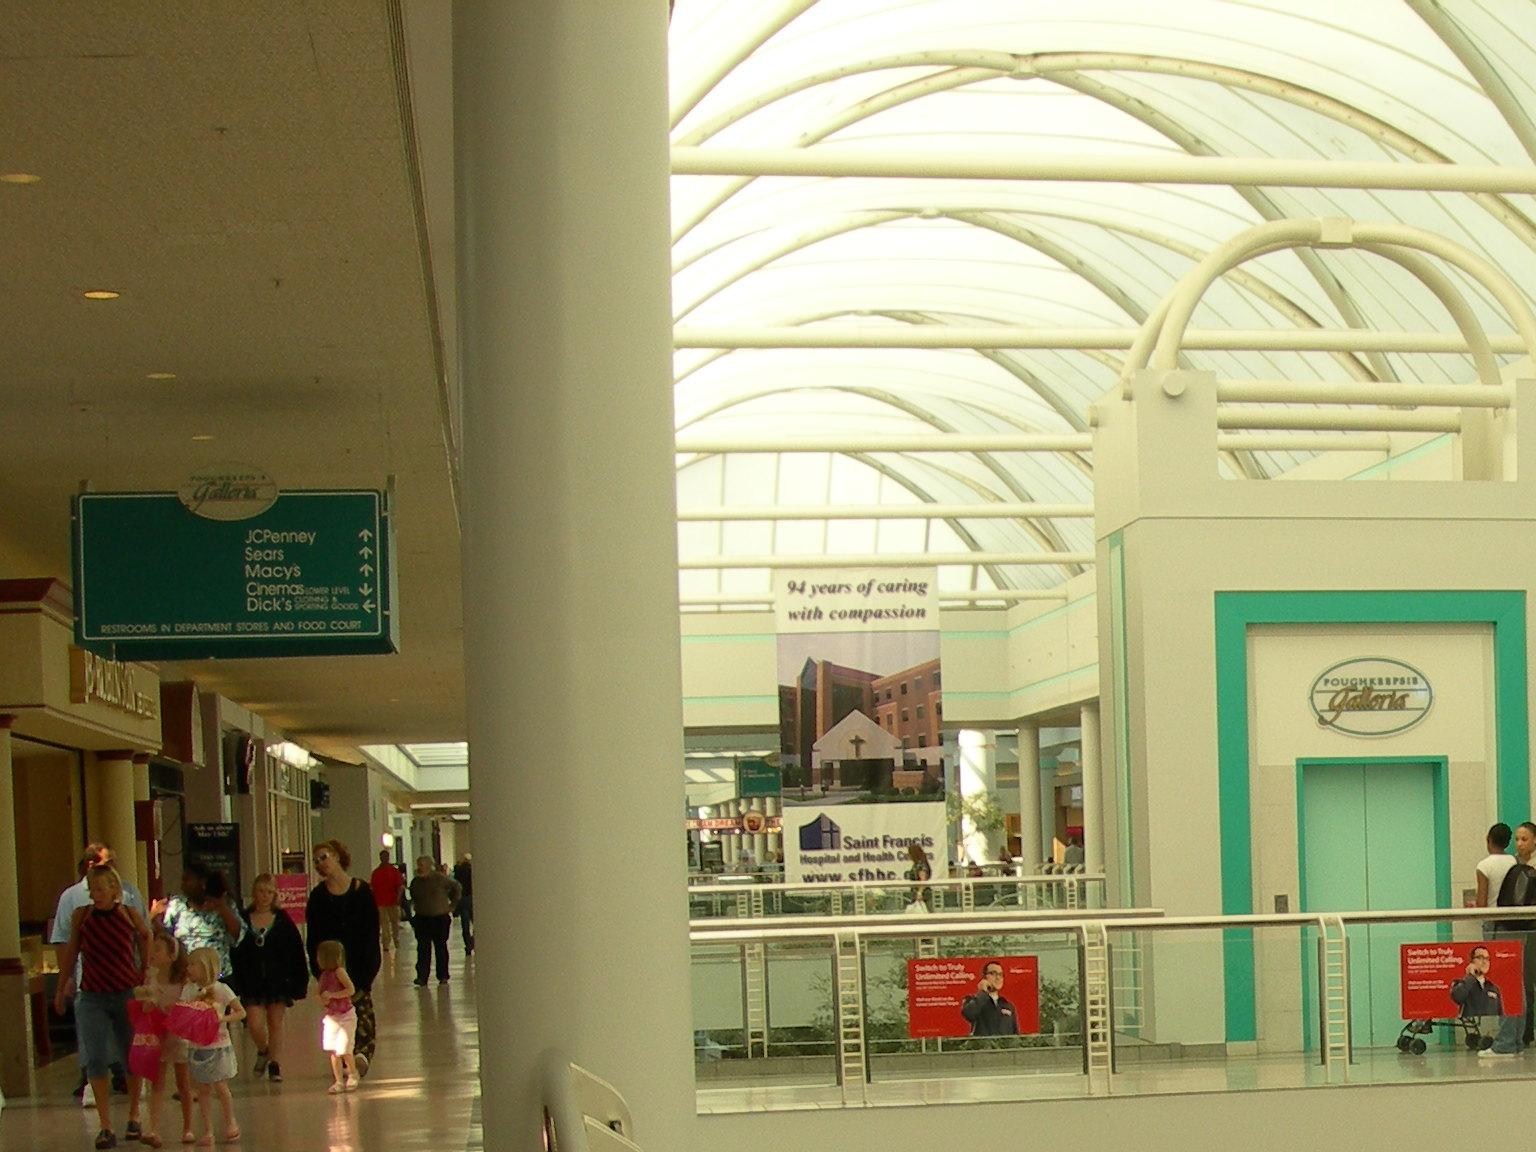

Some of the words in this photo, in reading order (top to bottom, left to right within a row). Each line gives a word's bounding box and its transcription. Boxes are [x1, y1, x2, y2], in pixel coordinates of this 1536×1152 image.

[244, 529, 317, 546] JCPenney
[244, 546, 285, 561] Sears
[246, 581, 305, 597] Cinemas
[787, 580, 807, 594] 94
[808, 582, 853, 599] years
[856, 578, 876, 597] of
[877, 578, 929, 597] caring
[246, 597, 293, 612] Dick's
[788, 606, 824, 621] with
[828, 604, 927, 623] compassion
[100, 623, 157, 634] RESTROOMS
[160, 623, 171, 633] IN
[175, 622, 233, 633] DEPARTMENT
[236, 622, 269, 632] STORES
[273, 621, 294, 631] AND
[298, 621, 326, 631] FOOD
[330, 620, 362, 631] COURT
[1323, 676, 1419, 687] POUGHKEEPSIE
[843, 835, 880, 849] Saint
[882, 833, 934, 849] Francis
[799, 853, 840, 866] Hospital
[842, 852, 861, 863] and
[862, 850, 895, 862] Health
